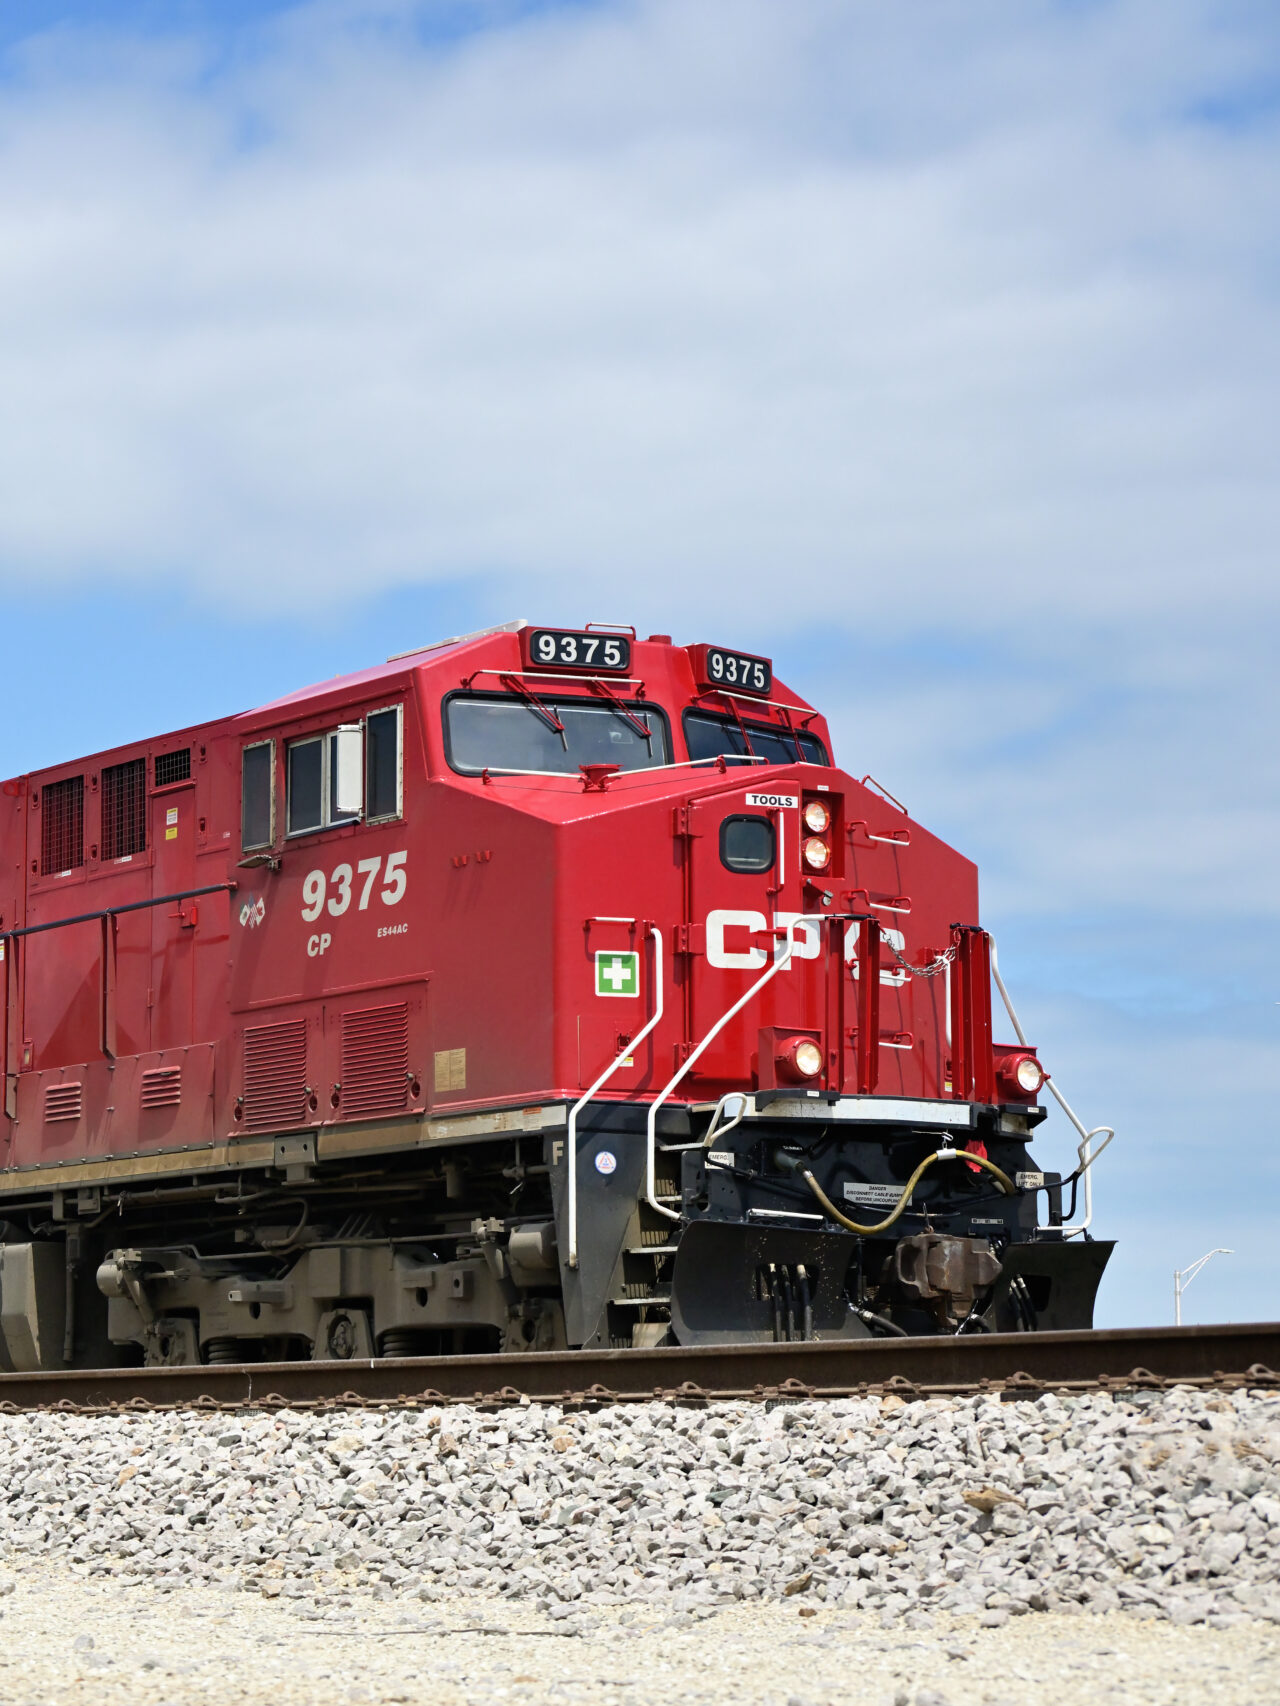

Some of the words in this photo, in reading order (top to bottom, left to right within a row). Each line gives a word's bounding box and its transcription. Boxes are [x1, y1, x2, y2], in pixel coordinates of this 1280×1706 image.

[538, 634, 621, 666] 9375
[711, 653, 765, 689] 9375
[751, 794, 793, 807] TOOLS
[301, 850, 408, 922] 9375
[377, 923, 408, 938] ES44AC
[307, 933, 331, 957] CP
[552, 1140, 564, 1166] F
